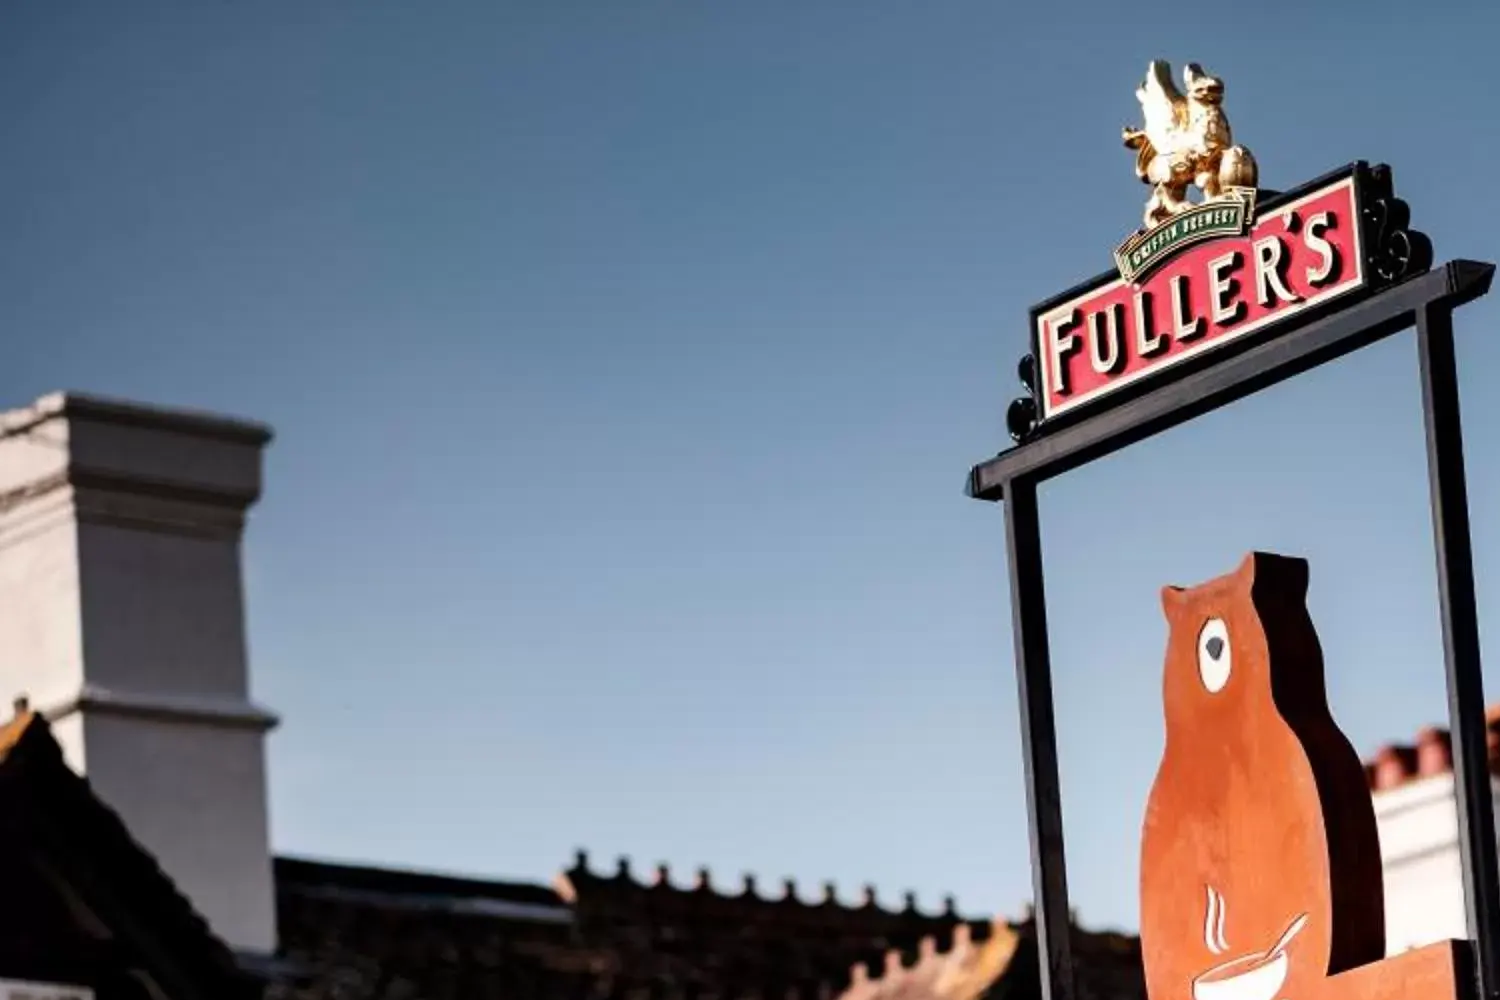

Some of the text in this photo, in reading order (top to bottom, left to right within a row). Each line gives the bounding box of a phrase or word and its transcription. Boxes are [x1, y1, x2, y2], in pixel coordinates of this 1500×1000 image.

[1132, 208, 1238, 266] GRIFFIN BREWERY
[1048, 210, 1342, 395] FULLER'S
